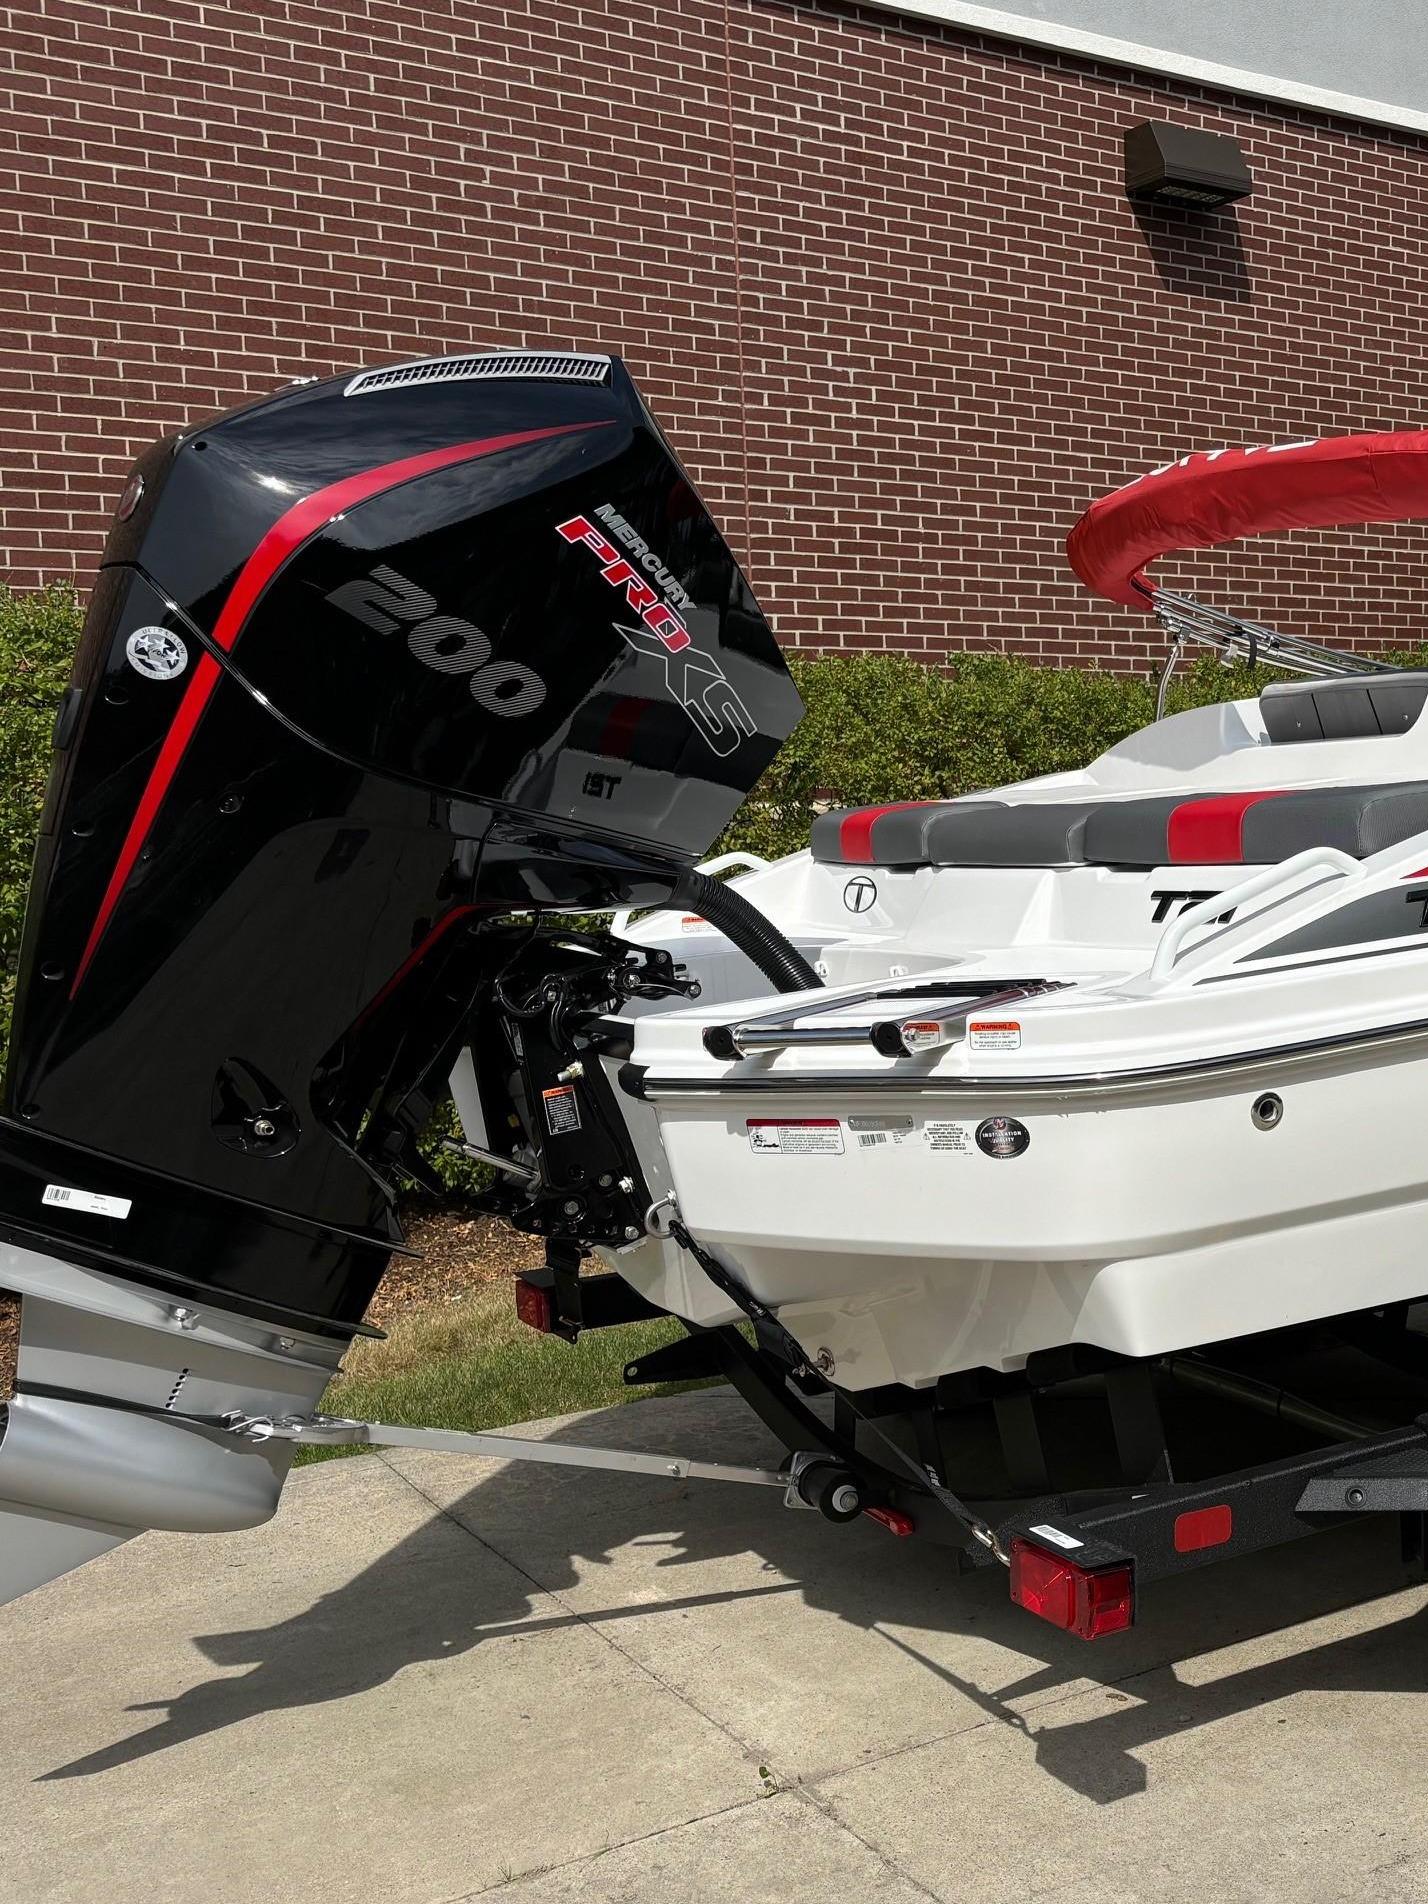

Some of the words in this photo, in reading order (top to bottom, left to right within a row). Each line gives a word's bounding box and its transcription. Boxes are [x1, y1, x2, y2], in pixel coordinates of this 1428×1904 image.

[555, 515, 691, 653] PRO
[594, 503, 697, 610] MERCURY
[324, 564, 547, 718] 200
[612, 597, 758, 757] XS
